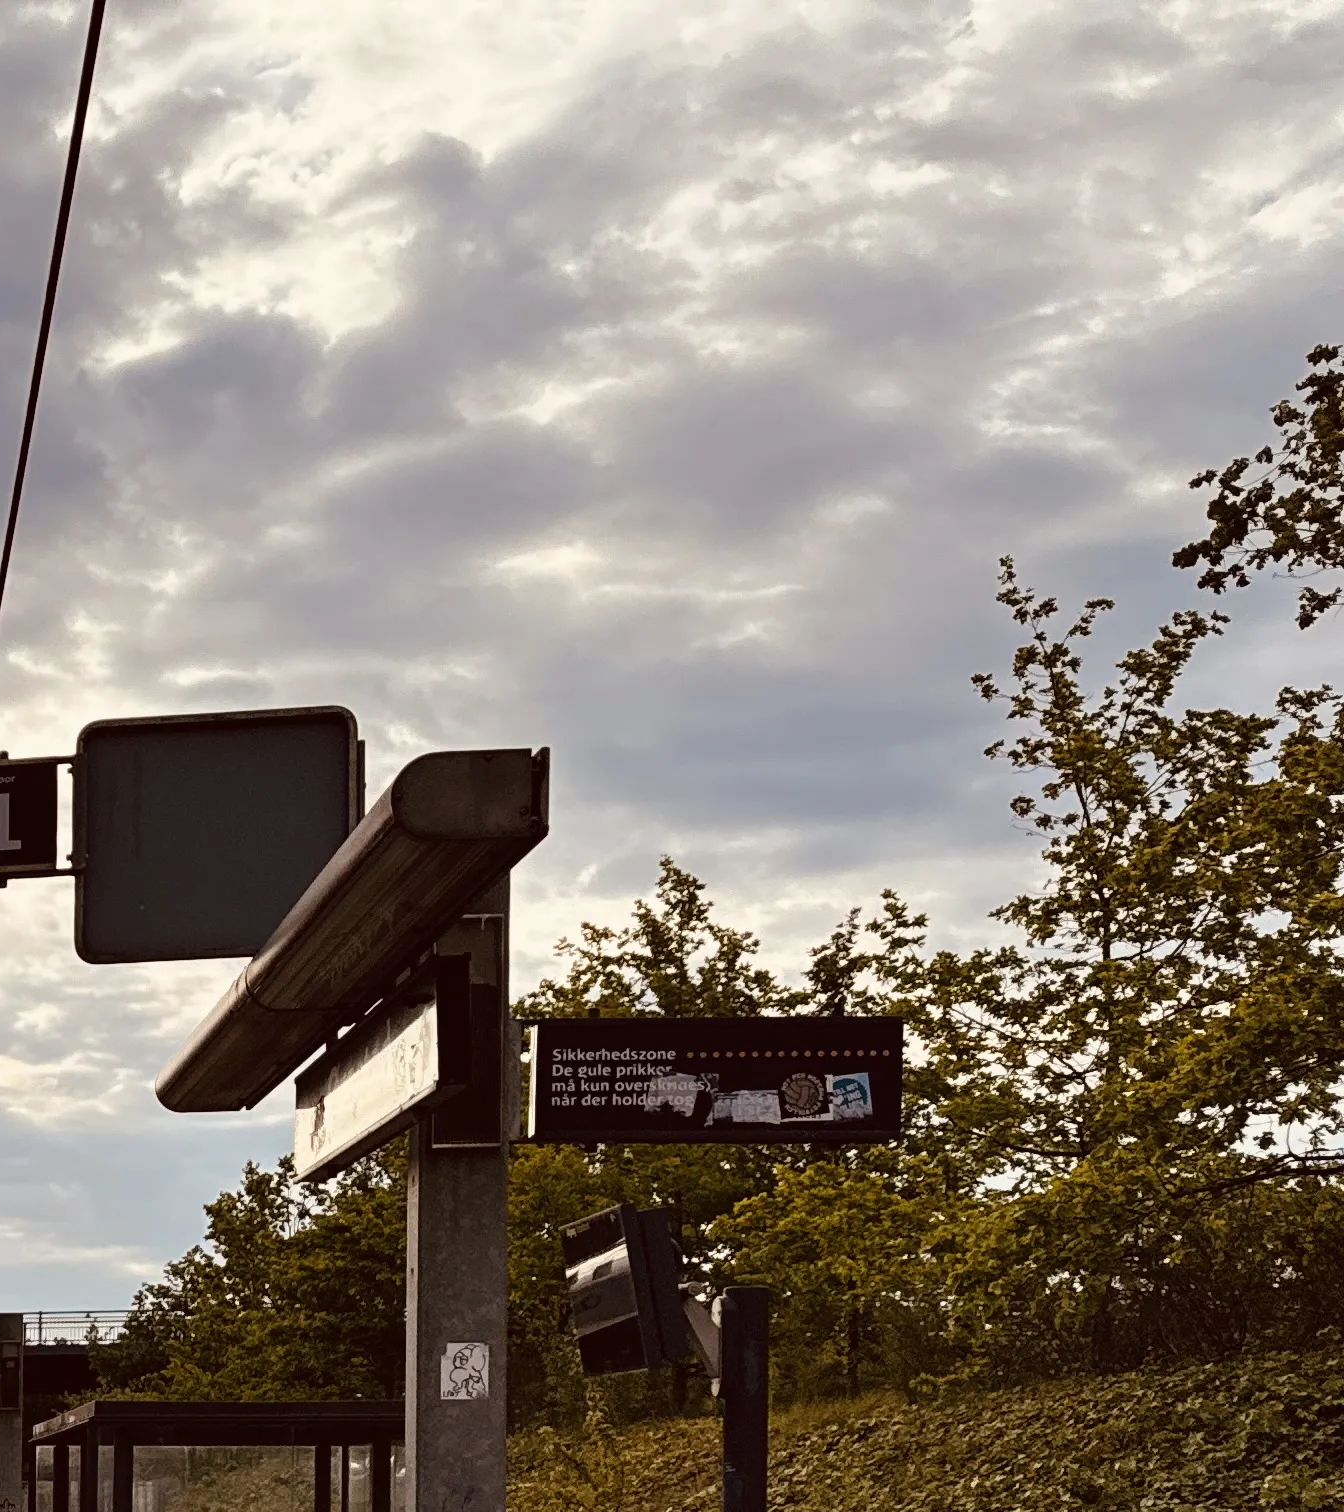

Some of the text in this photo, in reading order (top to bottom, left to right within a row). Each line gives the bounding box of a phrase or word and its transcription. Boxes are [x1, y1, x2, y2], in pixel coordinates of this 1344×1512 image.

[552, 1048, 677, 1062] Sikkerhedszone
[551, 1064, 574, 1077] De
[577, 1063, 612, 1079] gule
[551, 1078, 576, 1092] må
[580, 1079, 610, 1092] kun
[551, 1093, 577, 1107] når
[581, 1093, 609, 1107] der
